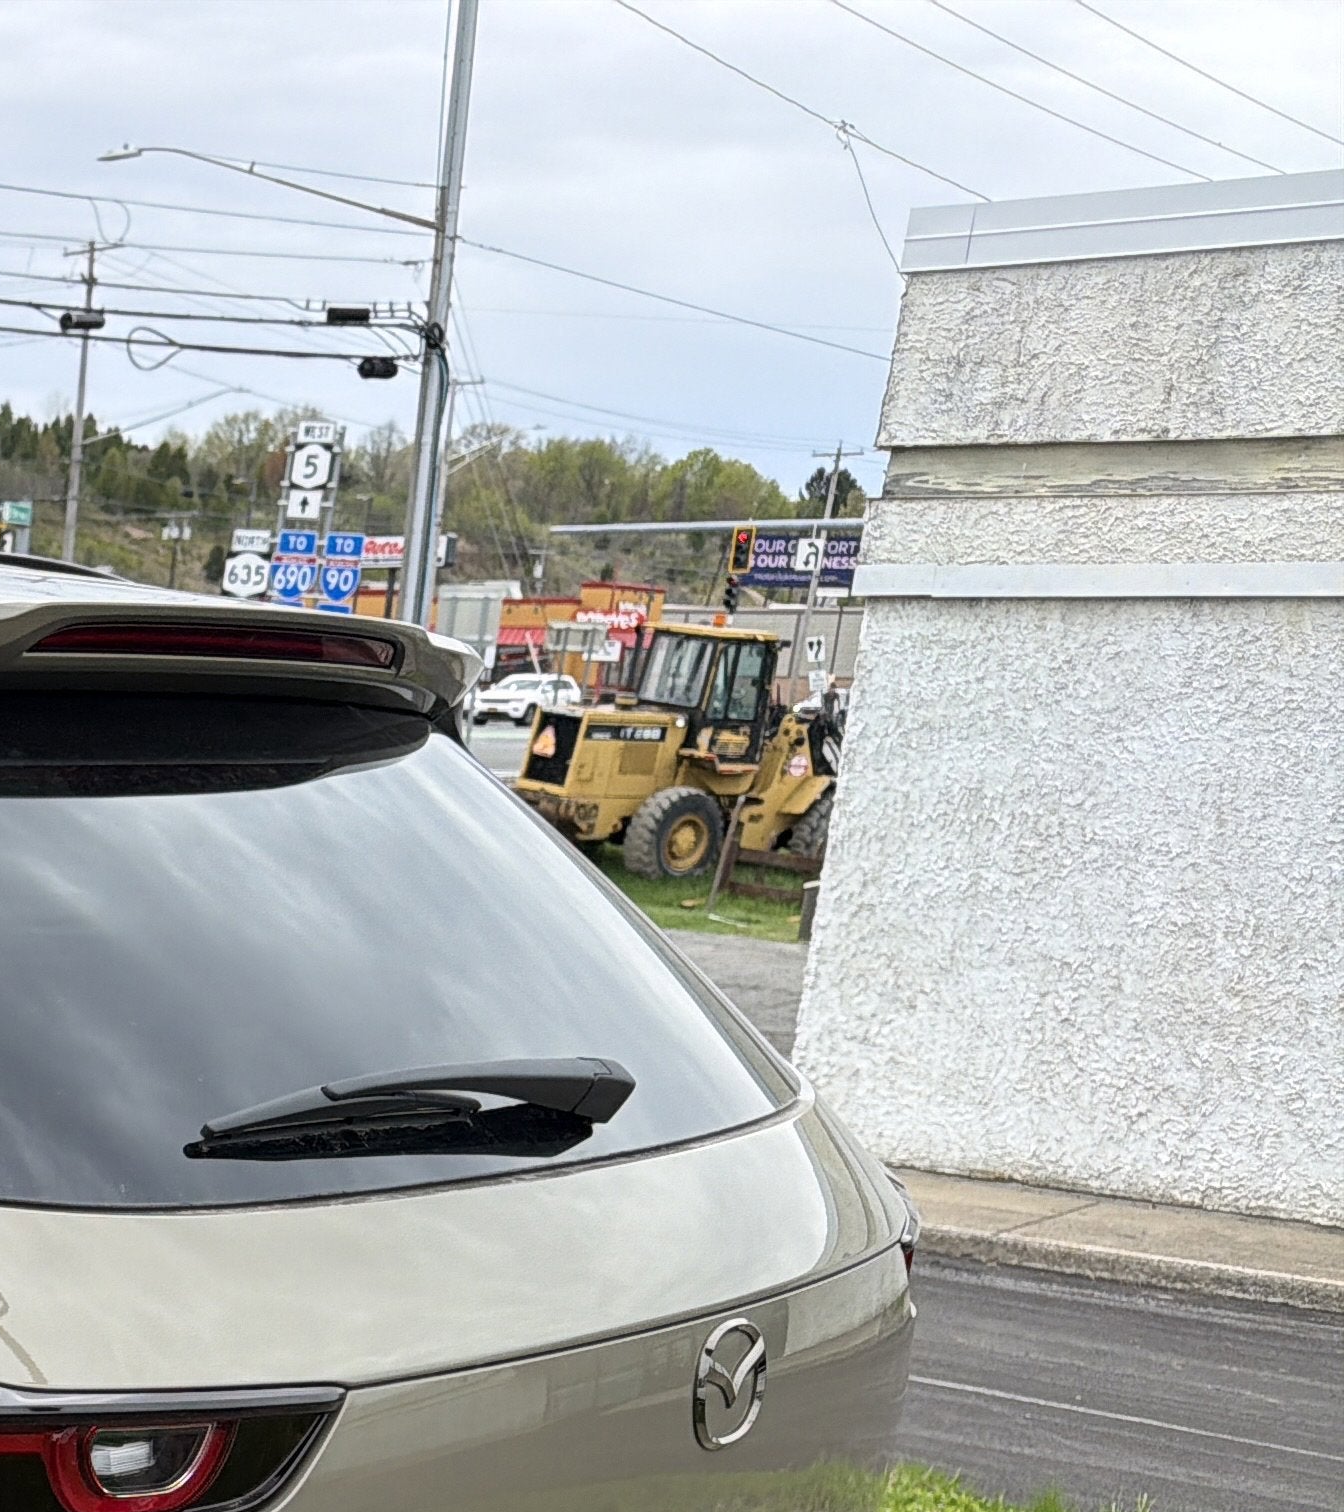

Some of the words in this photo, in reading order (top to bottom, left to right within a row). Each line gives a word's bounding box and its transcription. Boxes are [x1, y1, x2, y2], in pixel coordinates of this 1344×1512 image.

[303, 425, 331, 438] WEST
[303, 454, 320, 479] 5
[288, 536, 308, 549] TO
[335, 539, 355, 553] TO
[754, 539, 786, 553] OUR
[757, 555, 787, 568] OUR
[228, 565, 265, 586] 635
[273, 565, 312, 592] 690
[326, 570, 354, 592] 90
